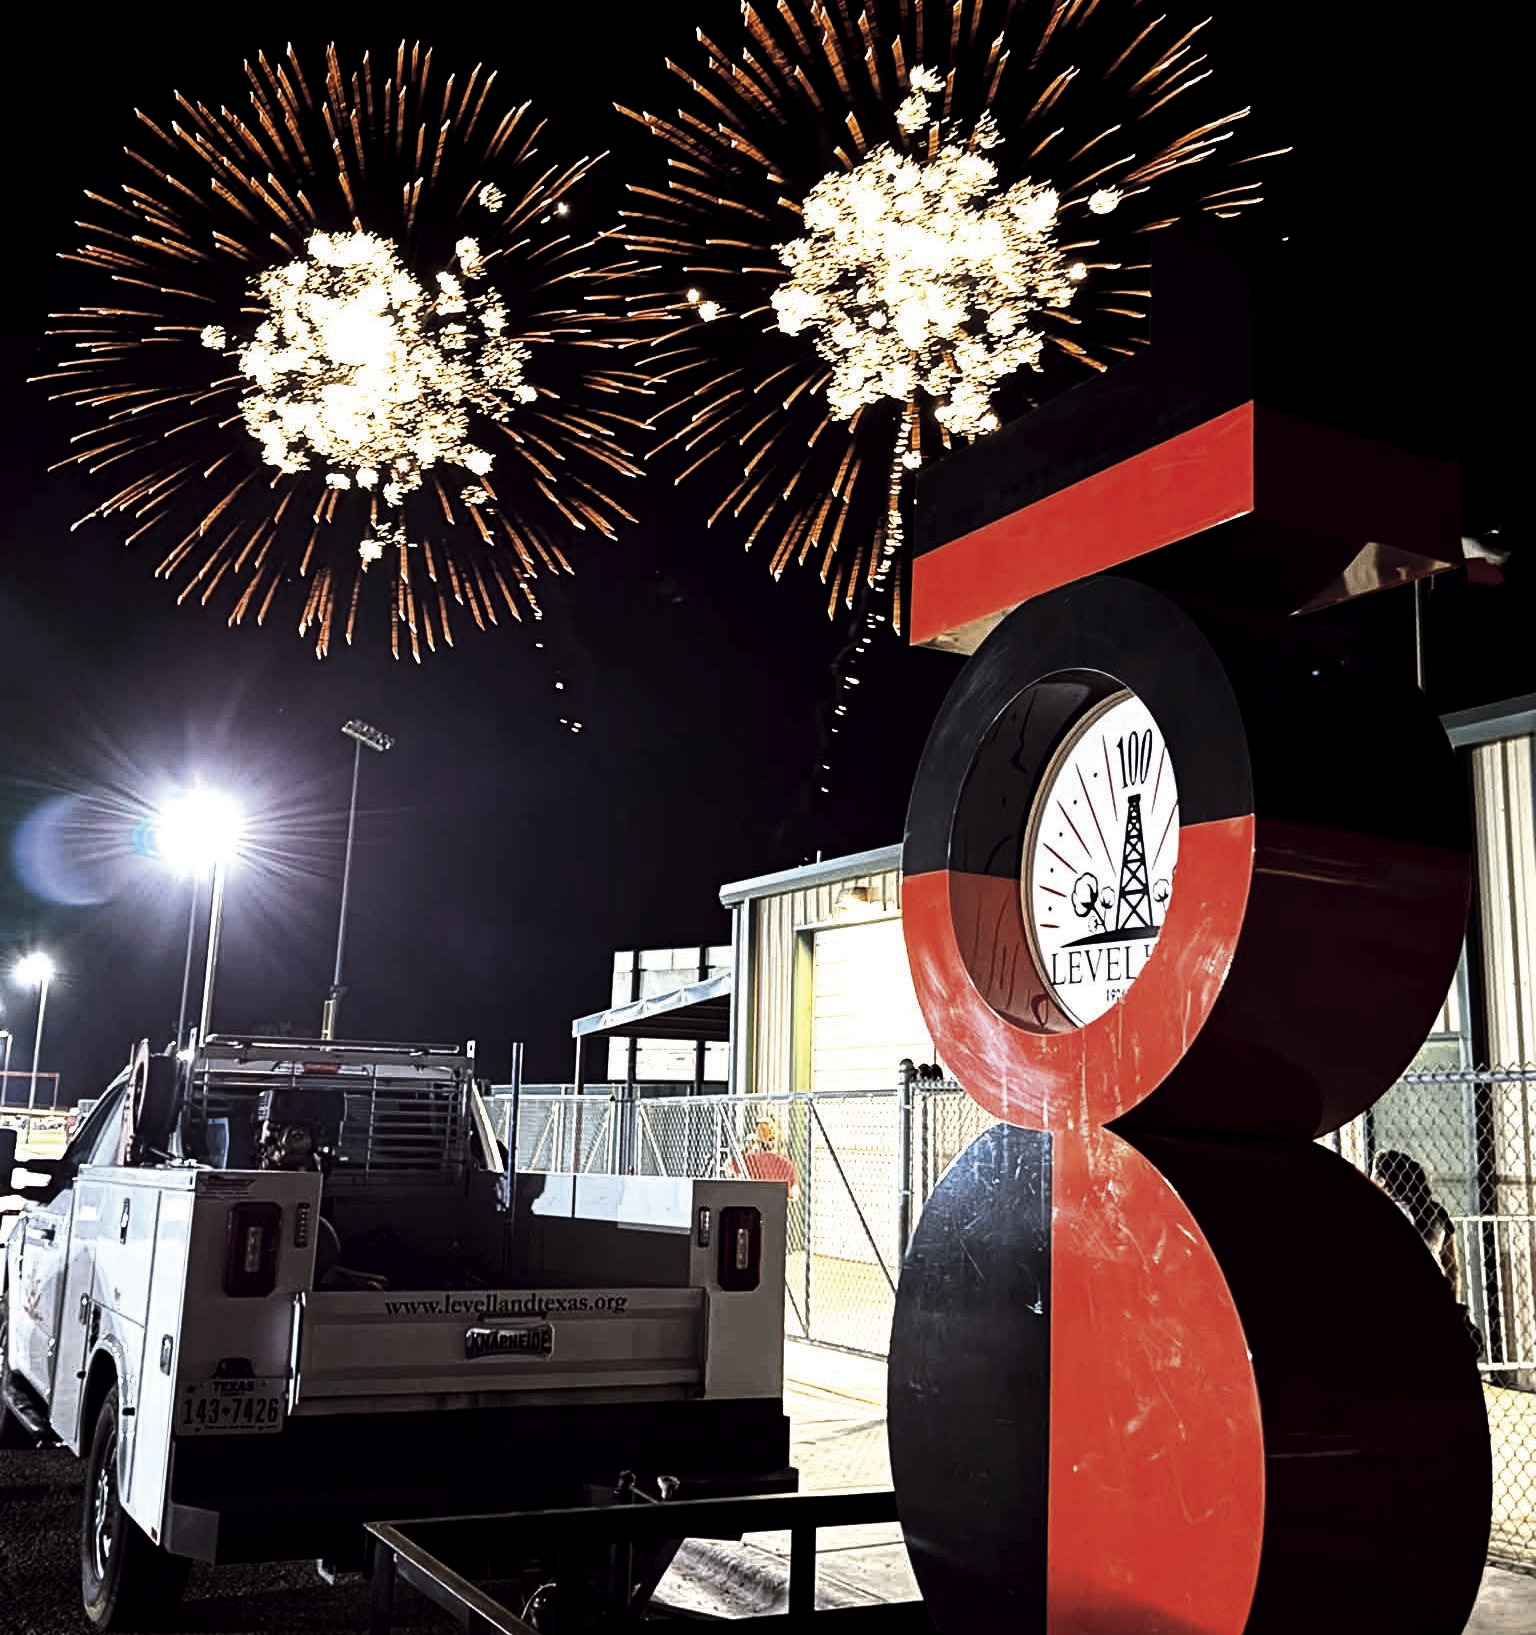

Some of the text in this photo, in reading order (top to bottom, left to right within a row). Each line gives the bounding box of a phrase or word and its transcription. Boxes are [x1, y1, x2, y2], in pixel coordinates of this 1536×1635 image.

[1117, 729, 1153, 788] 100
[384, 1293, 628, 1315] www.levellandtexas.org
[469, 1328, 550, 1351] KNAPHEIDE
[214, 1380, 255, 1391] TEXAS
